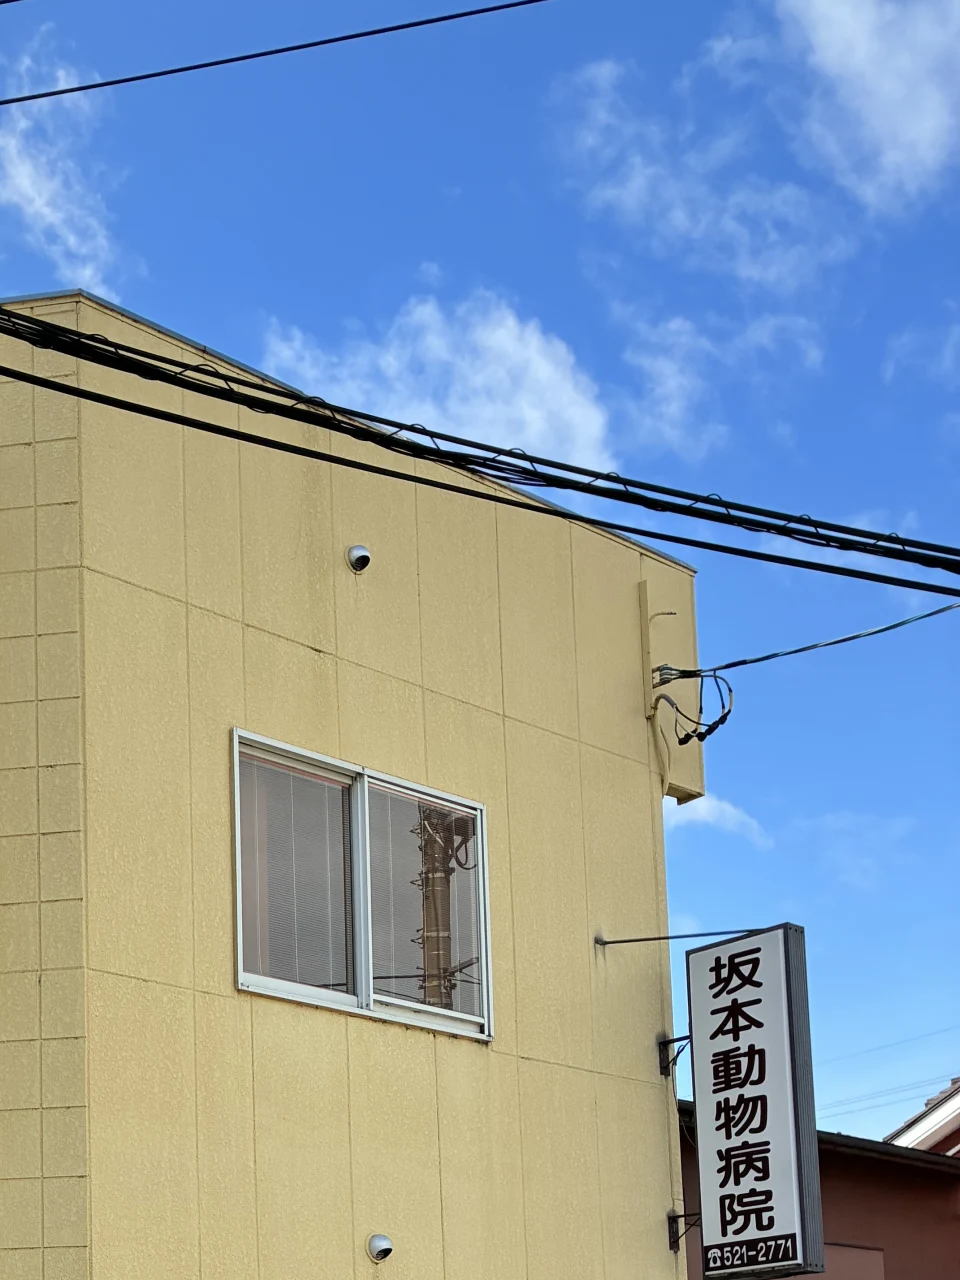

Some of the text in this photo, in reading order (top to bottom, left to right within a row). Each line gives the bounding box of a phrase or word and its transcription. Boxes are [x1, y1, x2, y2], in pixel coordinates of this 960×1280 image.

[708, 947, 775, 1238] 坂本動物病院
[723, 1238, 793, 1266] 521-2771
